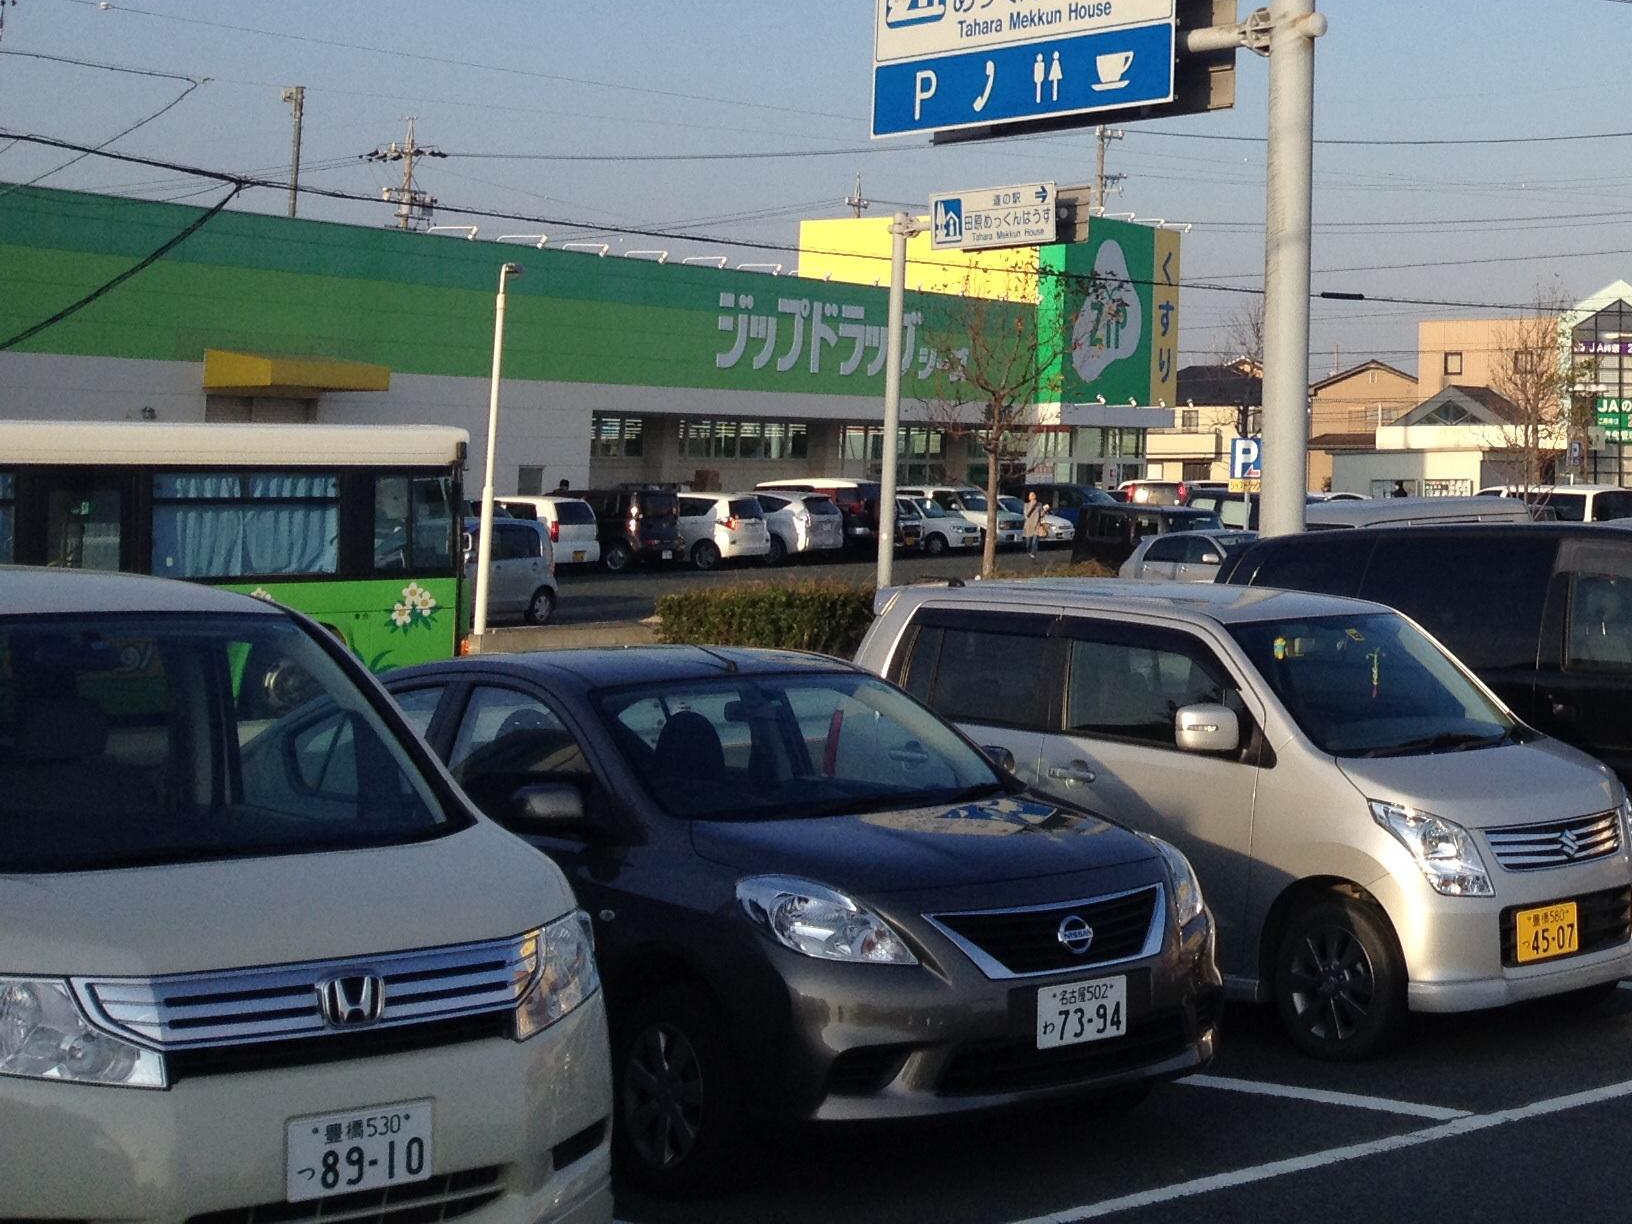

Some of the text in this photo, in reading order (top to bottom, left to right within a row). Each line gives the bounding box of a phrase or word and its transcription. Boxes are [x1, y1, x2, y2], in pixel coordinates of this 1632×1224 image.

[958, 0, 1112, 38] Tahara Mekkun House
[914, 70, 937, 120] P
[994, 192, 1021, 206] 道の駅
[965, 208, 1051, 230] 田原めっくんはうす
[972, 228, 1044, 241] Tahara Mekkun House
[716, 292, 923, 376] ジップドラッグ
[1158, 251, 1175, 383] くすり
[1235, 439, 1258, 478] P
[1531, 923, 1575, 954] 45-07
[1059, 983, 1109, 1005] 名古屋502
[1042, 1001, 1122, 1041] わ 73-94
[297, 1137, 424, 1189] つ 89-10
